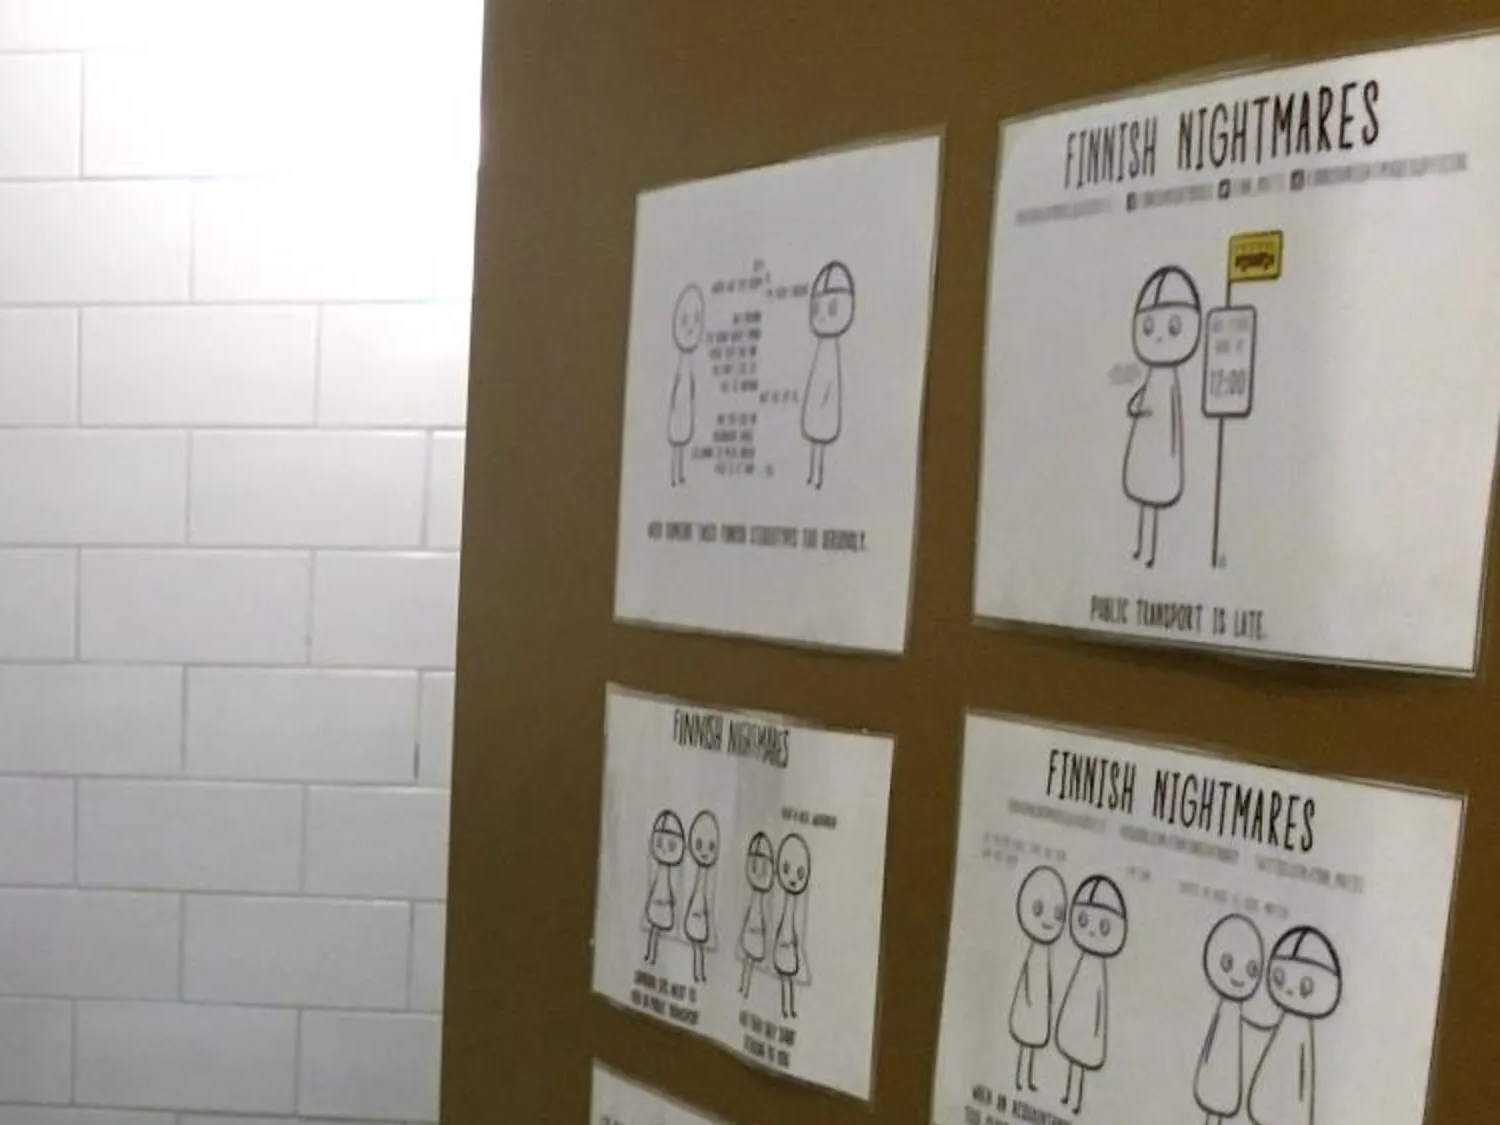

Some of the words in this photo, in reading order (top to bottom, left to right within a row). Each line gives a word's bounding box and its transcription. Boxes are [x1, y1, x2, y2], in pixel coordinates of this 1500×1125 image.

[1065, 116, 1157, 189] FINNISH
[1178, 80, 1380, 171] NIGHTMARES
[1090, 594, 1129, 624] PUBLIC
[1136, 598, 1204, 633] TRANSPORT
[1213, 607, 1226, 635] IS
[673, 708, 723, 752] FINNISH
[1046, 749, 1136, 814] FINNISH
[1152, 769, 1315, 852] NIGHTMARES
